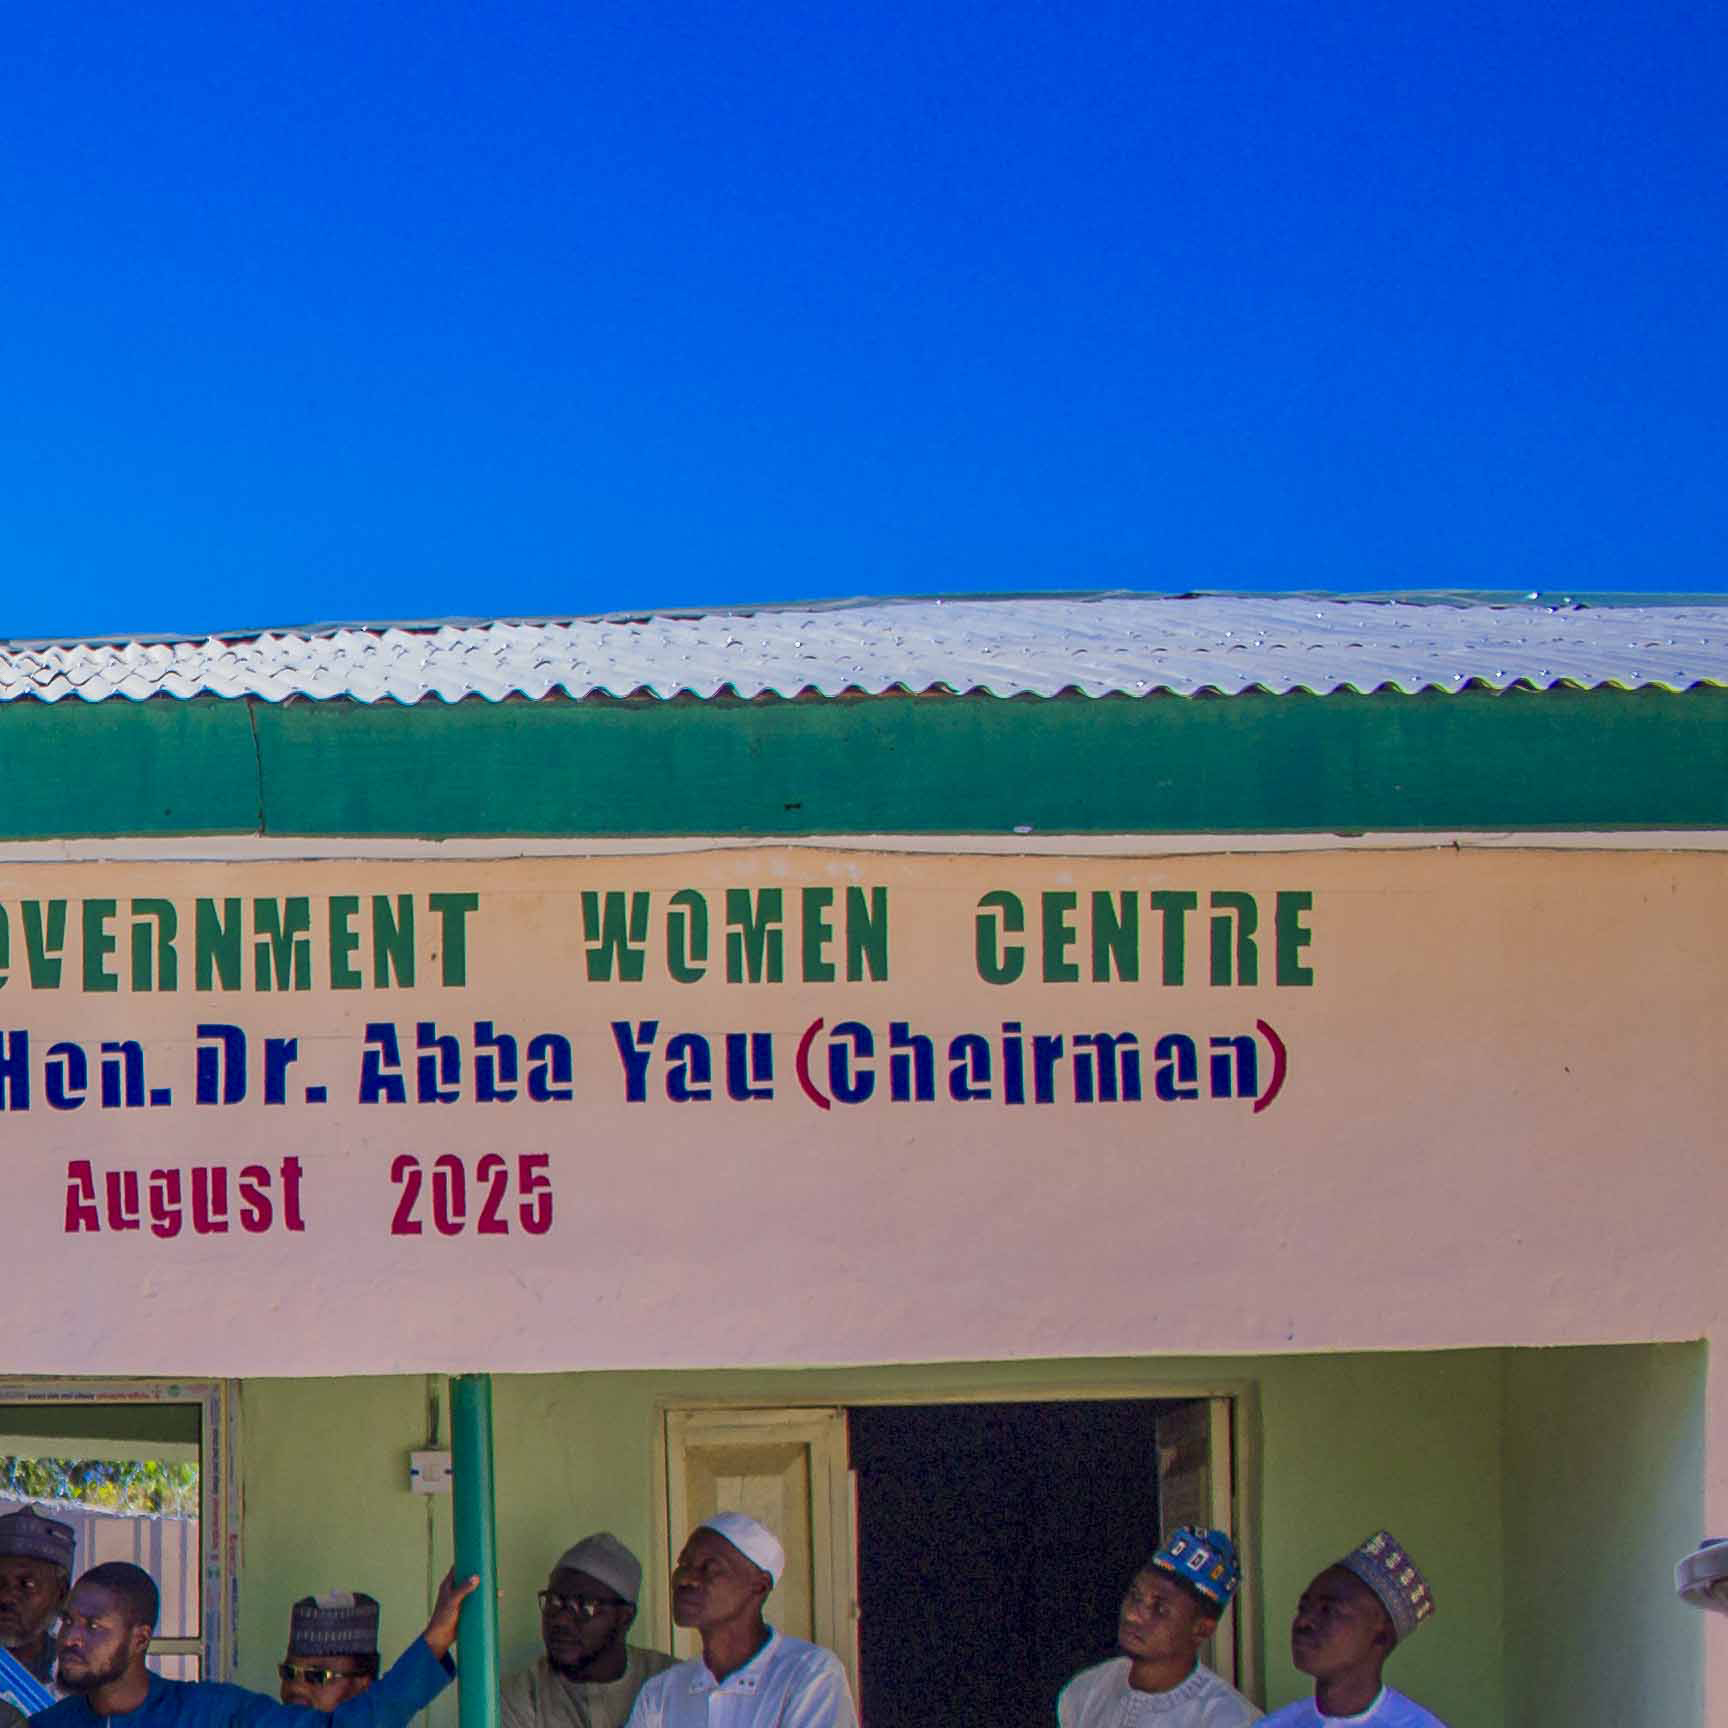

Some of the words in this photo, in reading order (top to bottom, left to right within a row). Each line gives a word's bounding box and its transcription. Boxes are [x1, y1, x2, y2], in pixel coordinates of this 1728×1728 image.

[582, 886, 889, 985] WOMEN
[976, 889, 1315, 986] CENTRE
[195, 1022, 328, 1106] Dr.
[357, 1020, 573, 1105] Abba
[64, 1155, 305, 1239] August
[390, 1152, 553, 1236] 2025
